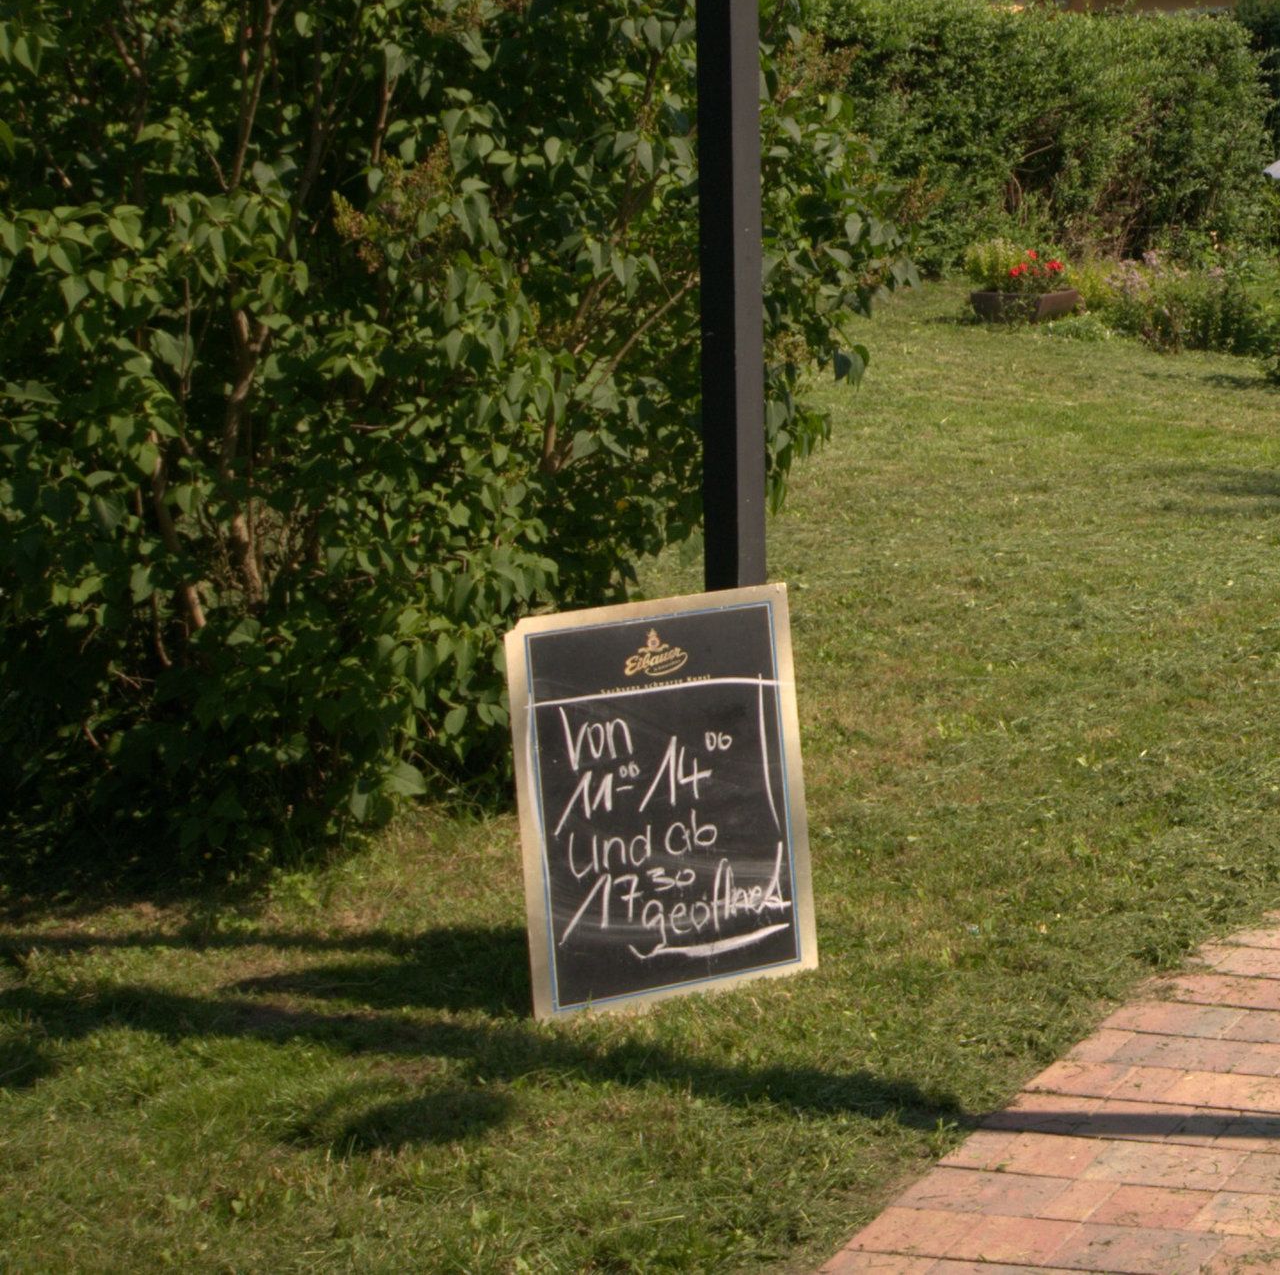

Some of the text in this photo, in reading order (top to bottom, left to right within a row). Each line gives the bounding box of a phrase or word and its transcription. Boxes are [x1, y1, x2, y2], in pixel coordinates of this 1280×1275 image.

[624, 647, 687, 676] Eibauer
[559, 706, 634, 771] Von
[665, 809, 718, 855] ab
